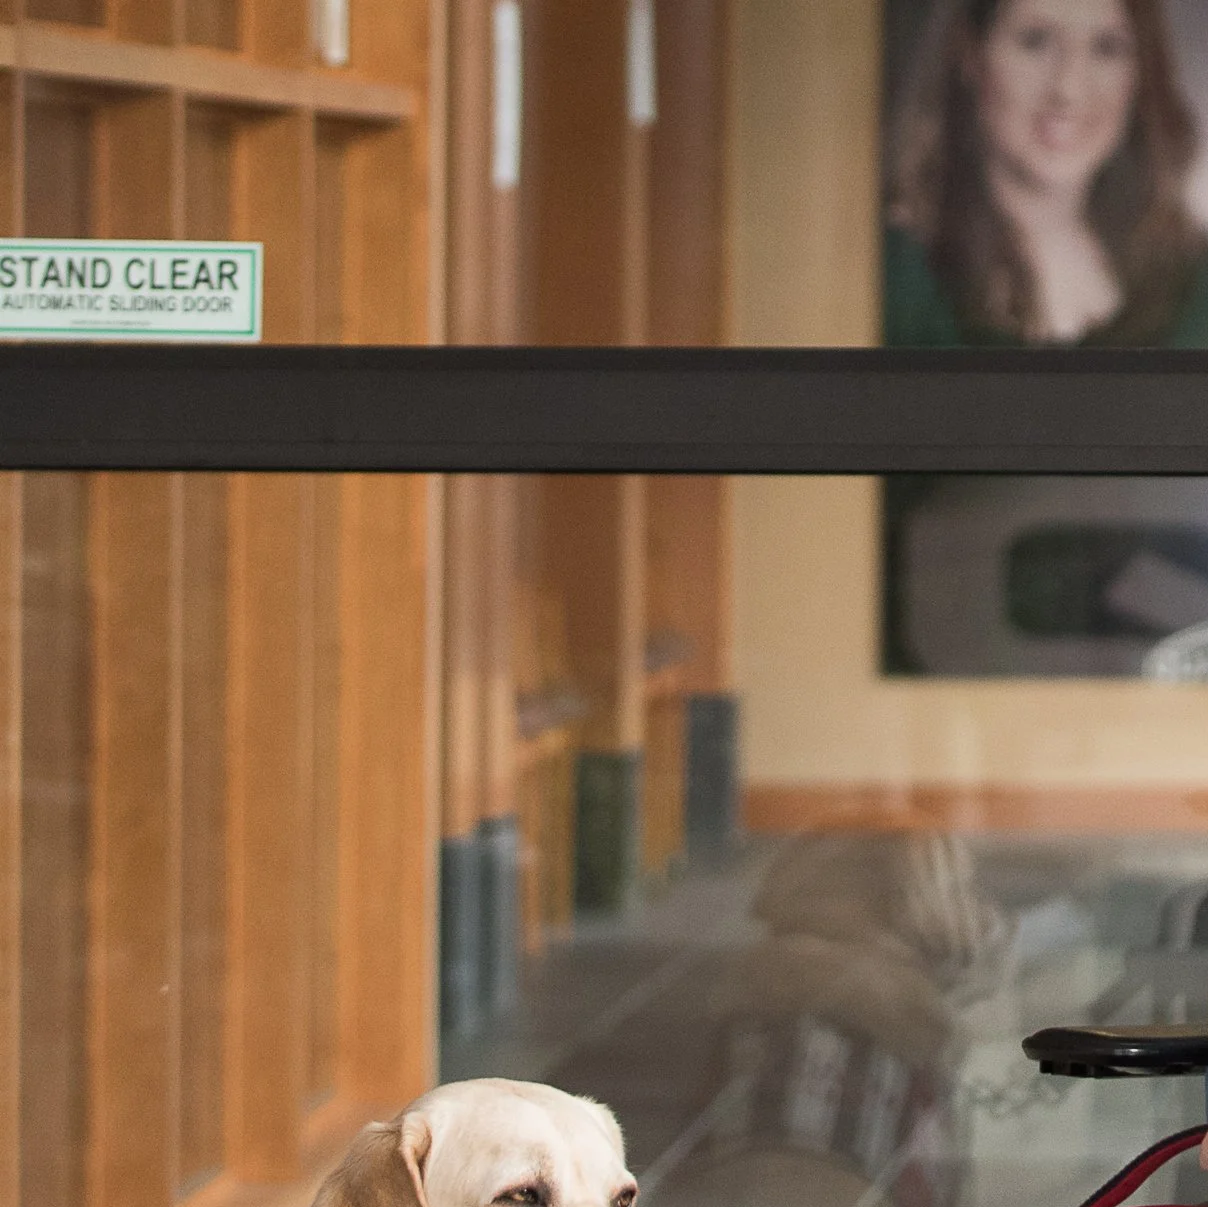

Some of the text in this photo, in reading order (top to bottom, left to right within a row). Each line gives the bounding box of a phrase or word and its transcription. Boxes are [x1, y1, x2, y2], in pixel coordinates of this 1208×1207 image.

[0, 256, 239, 291] STAND CLEAR
[2, 294, 233, 313] AUTOMATIC SLIDING DOOR
